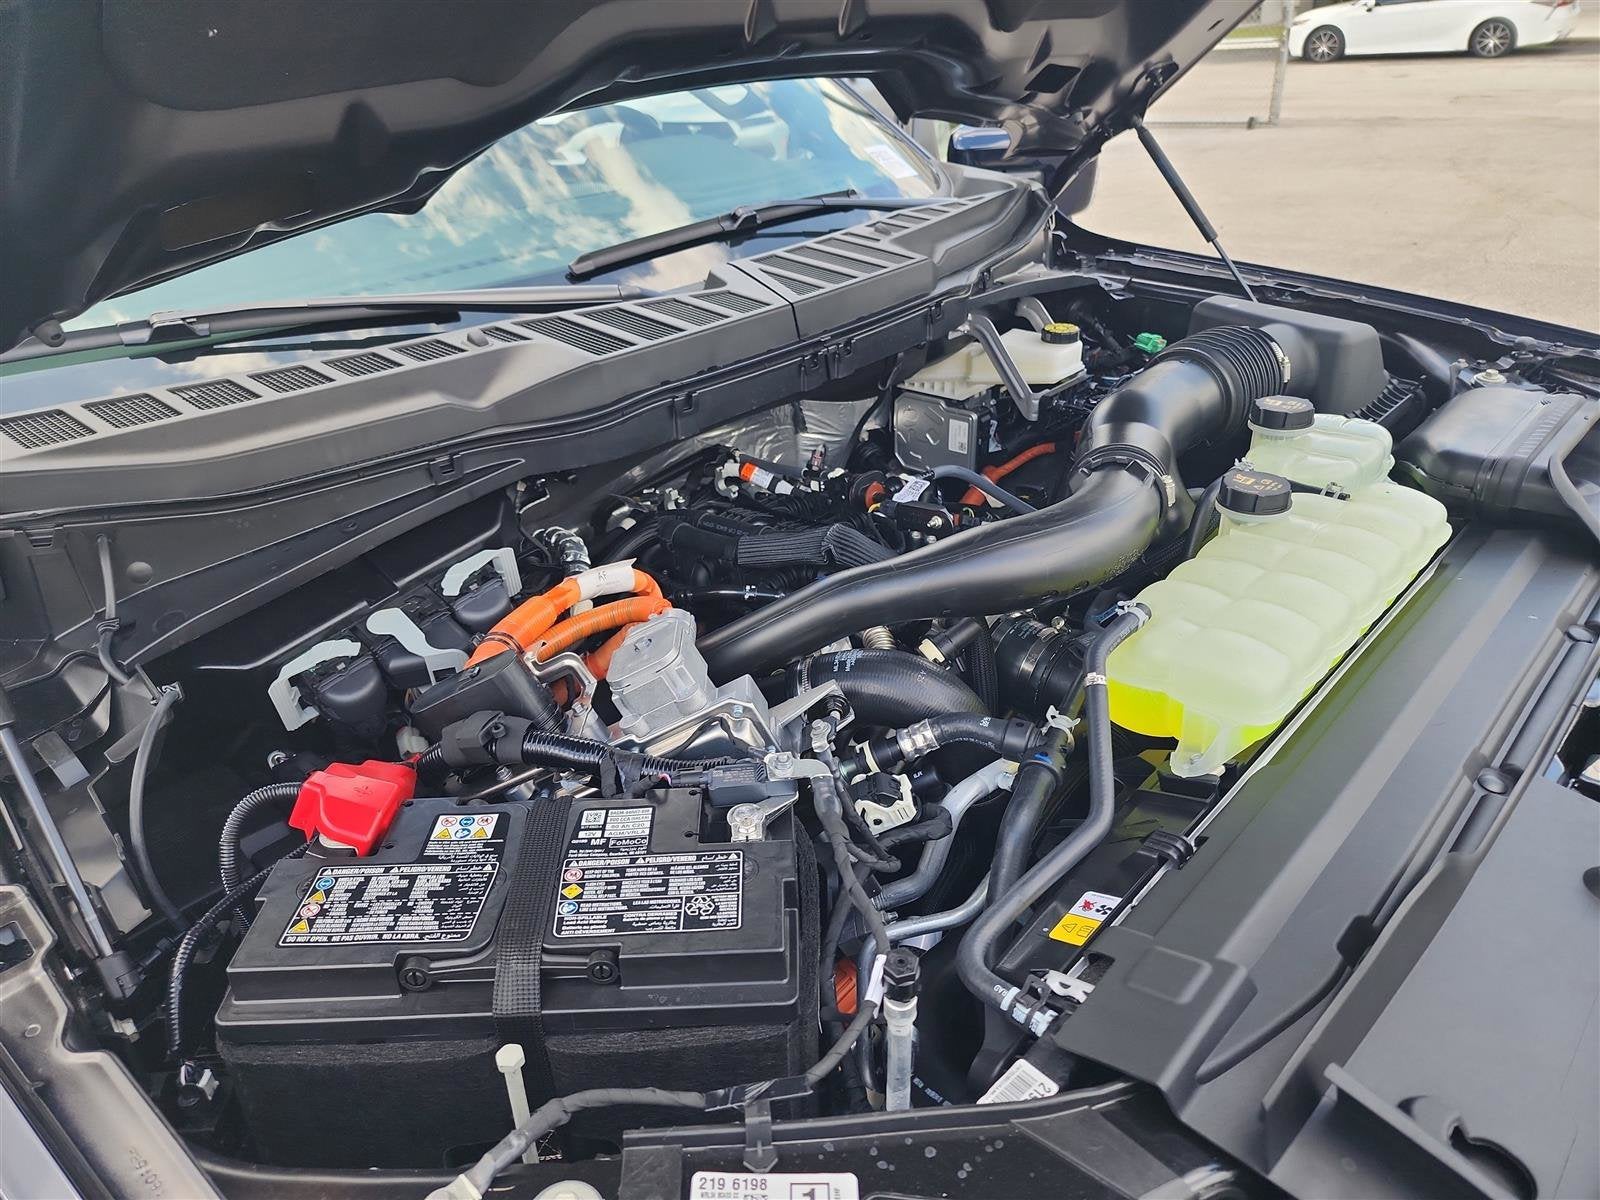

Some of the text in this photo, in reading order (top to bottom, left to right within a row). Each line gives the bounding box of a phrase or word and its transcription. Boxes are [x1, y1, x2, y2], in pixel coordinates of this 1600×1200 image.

[610, 838, 647, 846] FoMoCo
[578, 858, 630, 866] DANGER/POISON
[645, 855, 697, 863] PELIGRO/VENENO
[699, 1177, 767, 1190] 219 6198
